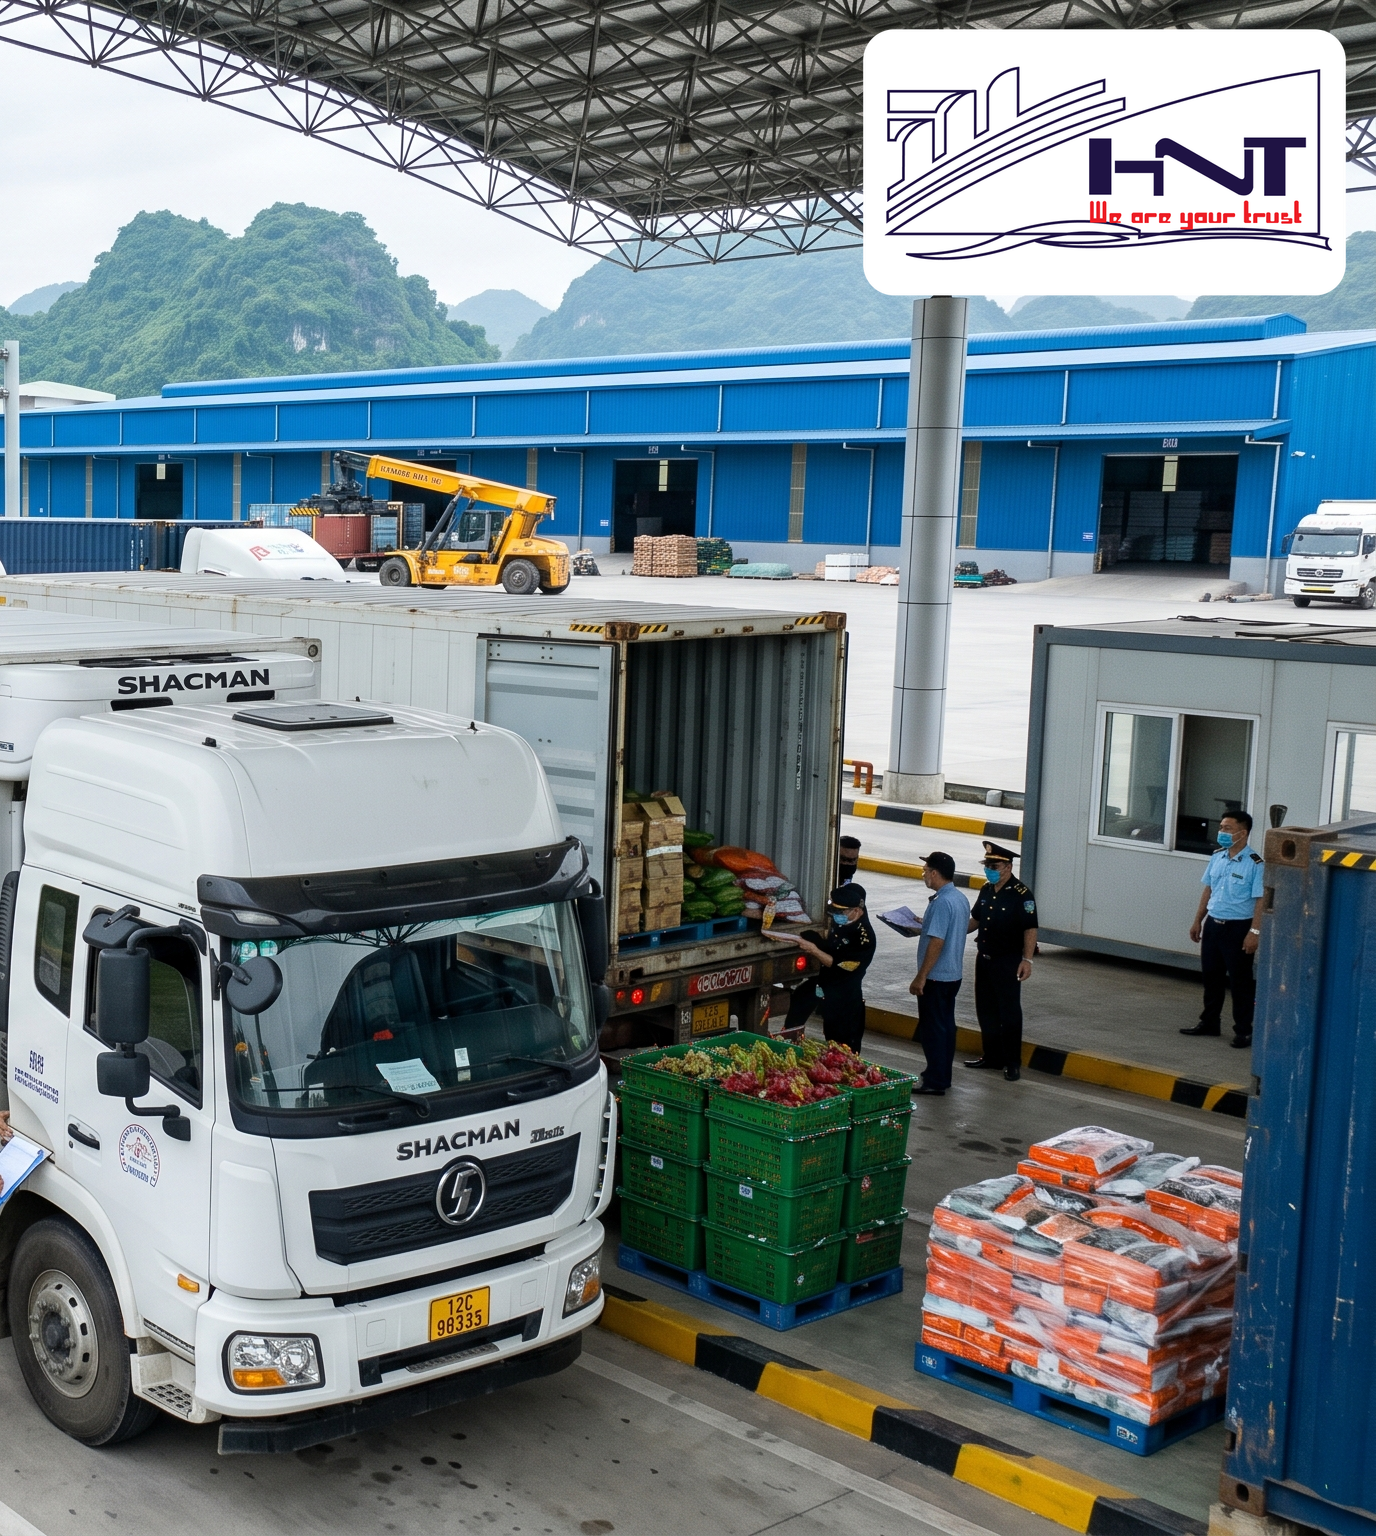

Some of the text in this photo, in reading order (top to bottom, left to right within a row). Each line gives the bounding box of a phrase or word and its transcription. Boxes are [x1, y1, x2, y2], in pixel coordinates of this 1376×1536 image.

[117, 668, 270, 695] SHACMAN
[396, 1118, 521, 1162] SHACMAN
[447, 1294, 474, 1316] 12C
[437, 1309, 482, 1337] 98335
